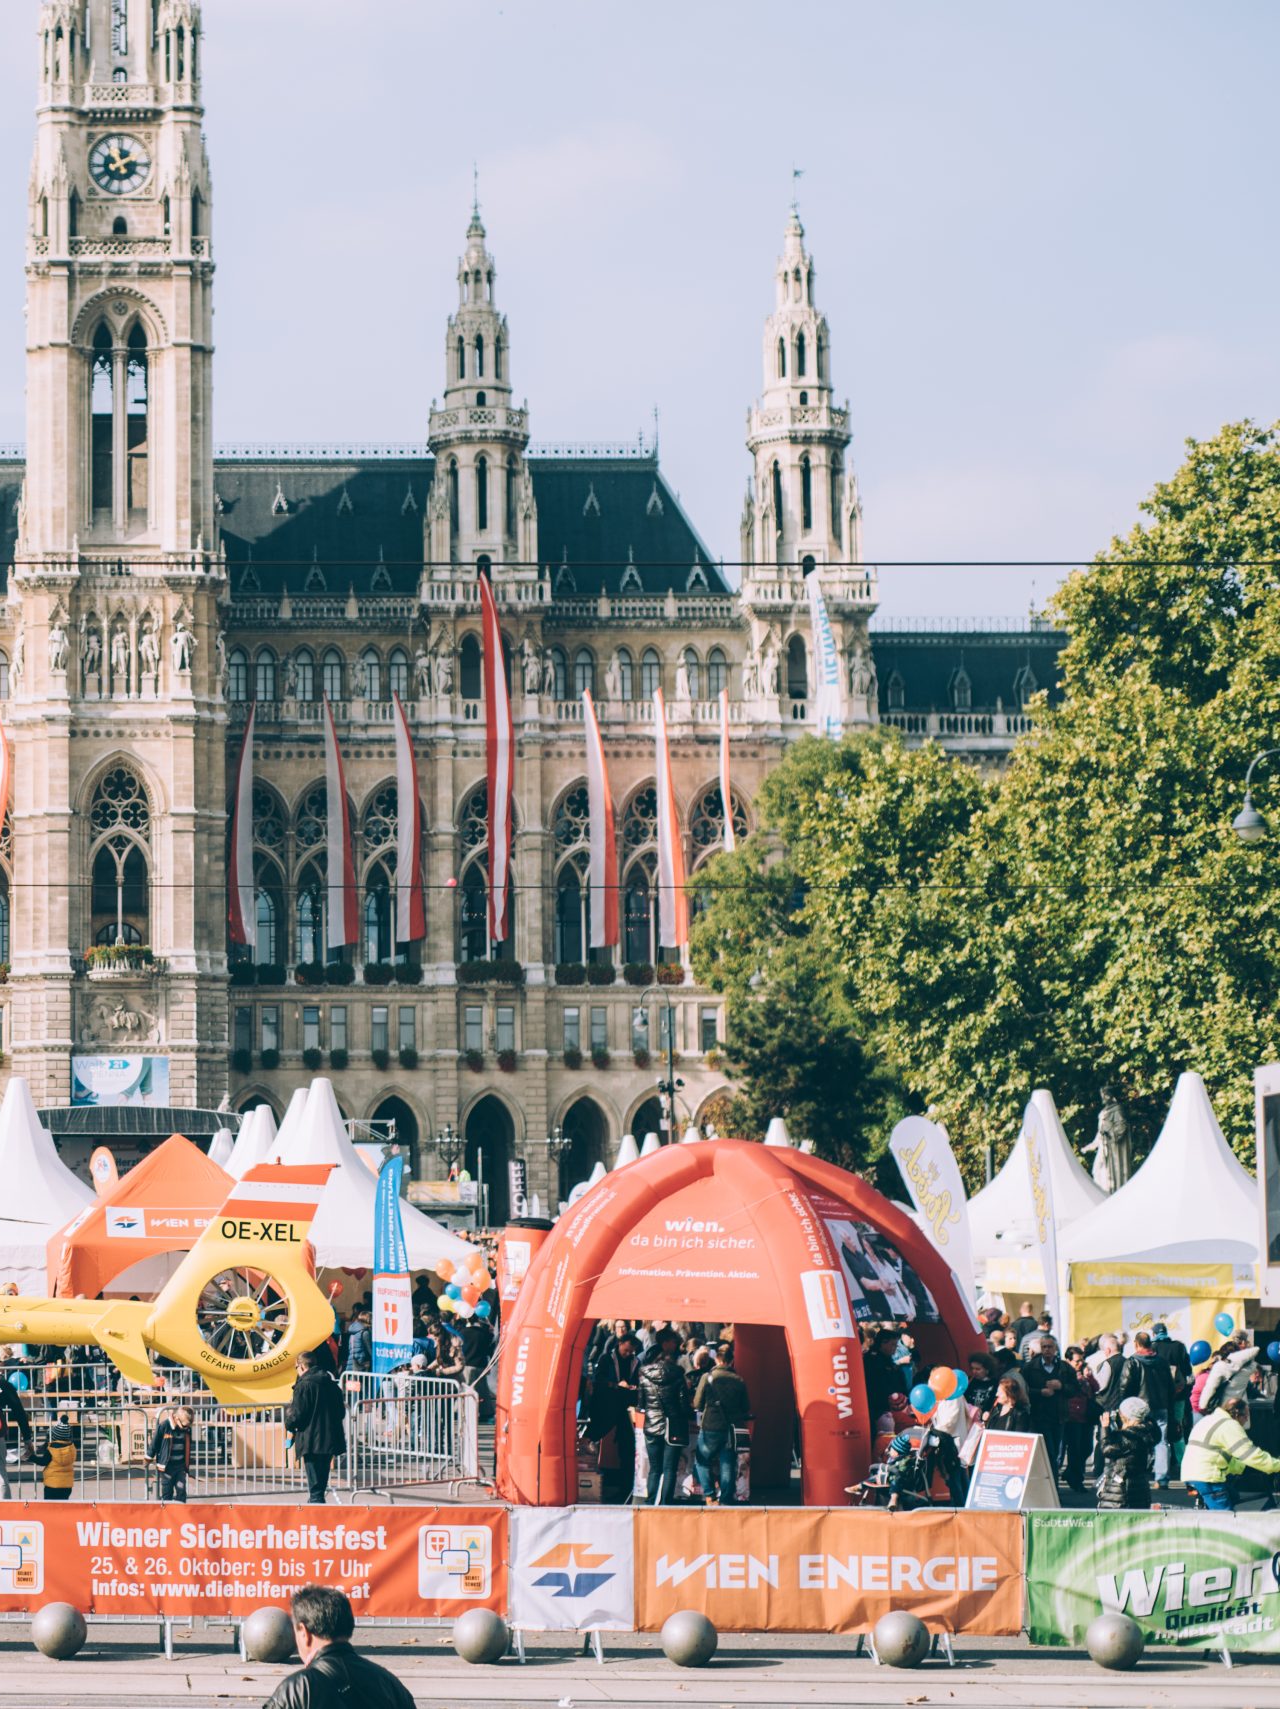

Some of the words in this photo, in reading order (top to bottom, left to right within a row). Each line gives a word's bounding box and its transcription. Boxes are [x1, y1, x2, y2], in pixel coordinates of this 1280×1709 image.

[511, 1162, 524, 1216] COFFEE
[150, 1217, 188, 1229] WIEN
[221, 1220, 301, 1242] OE-XEL
[664, 1217, 725, 1233] wien.
[630, 1234, 649, 1247] da
[653, 1235, 677, 1248] bin
[681, 1236, 704, 1249] ich
[707, 1237, 756, 1250] sicher.
[618, 1267, 674, 1278] Information.
[675, 1269, 727, 1279] Prävention.
[727, 1270, 760, 1280] Aktion.
[200, 1350, 236, 1372] GEFAHR
[253, 1351, 291, 1373] DANGER
[511, 1336, 531, 1406] wien.
[828, 1346, 853, 1419] wien.
[76, 1521, 171, 1549] Wiener
[179, 1522, 387, 1551] Sicherheitsfest
[90, 1556, 120, 1576] 25.
[125, 1557, 140, 1576] &
[143, 1557, 174, 1576] 26.
[178, 1557, 257, 1578] Oktober:
[261, 1558, 273, 1577] 9
[278, 1559, 307, 1578] bis
[311, 1559, 335, 1578] 17
[340, 1559, 373, 1578] Uhr
[655, 1554, 779, 1589] WIEN
[799, 1554, 998, 1592] ENERGIE
[92, 1578, 145, 1597] Infos:
[1094, 1561, 1280, 1617] Wien
[1165, 1600, 1263, 1631] Qualität
